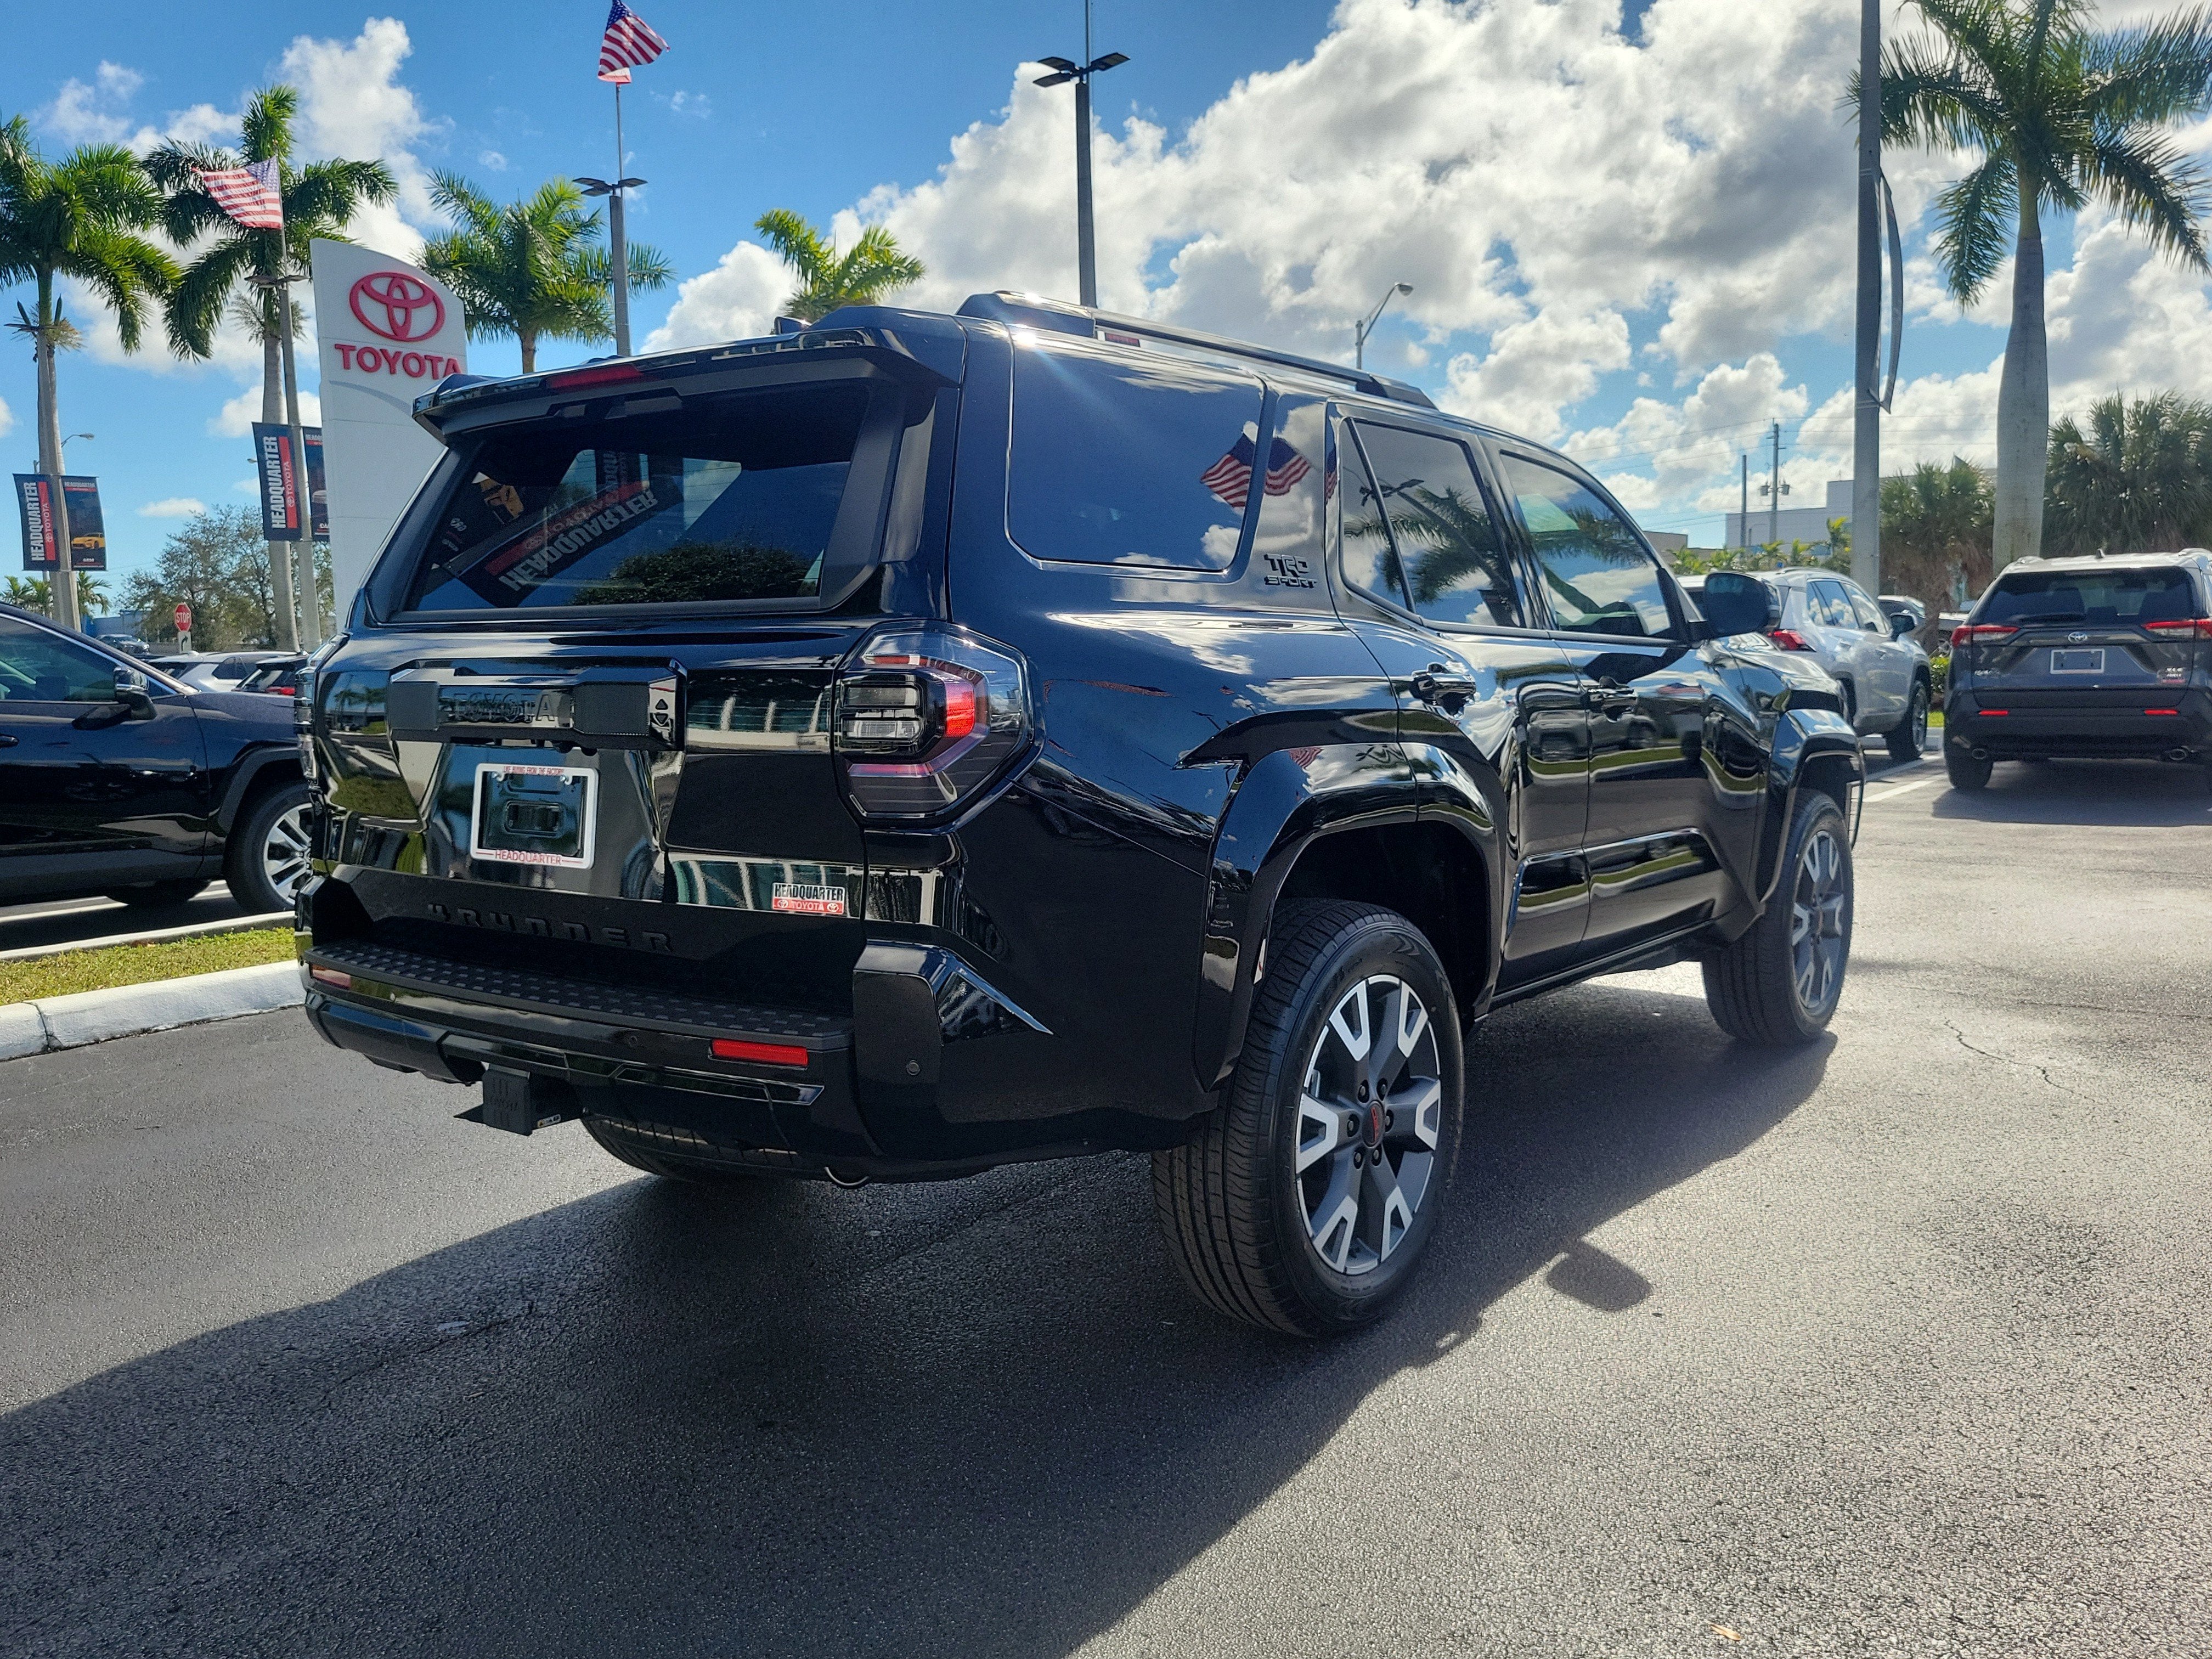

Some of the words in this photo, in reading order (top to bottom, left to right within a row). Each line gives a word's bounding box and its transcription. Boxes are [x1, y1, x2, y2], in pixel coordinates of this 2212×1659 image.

[335, 343, 462, 380] TOYOTA
[263, 437, 286, 528] HEADQUARTER
[284, 461, 294, 495] TOYOTA
[24, 482, 45, 561] HEADQUARTER
[42, 503, 53, 534] TOYOTA
[1263, 554, 1310, 577] TRD
[1264, 575, 1317, 589] SPORT
[176, 612, 190, 623] STOP
[454, 692, 555, 723] TOYOTA
[495, 850, 562, 865] HEADQUARTER
[775, 884, 843, 901] HEADQUARTER
[791, 900, 825, 911] TOYOTA
